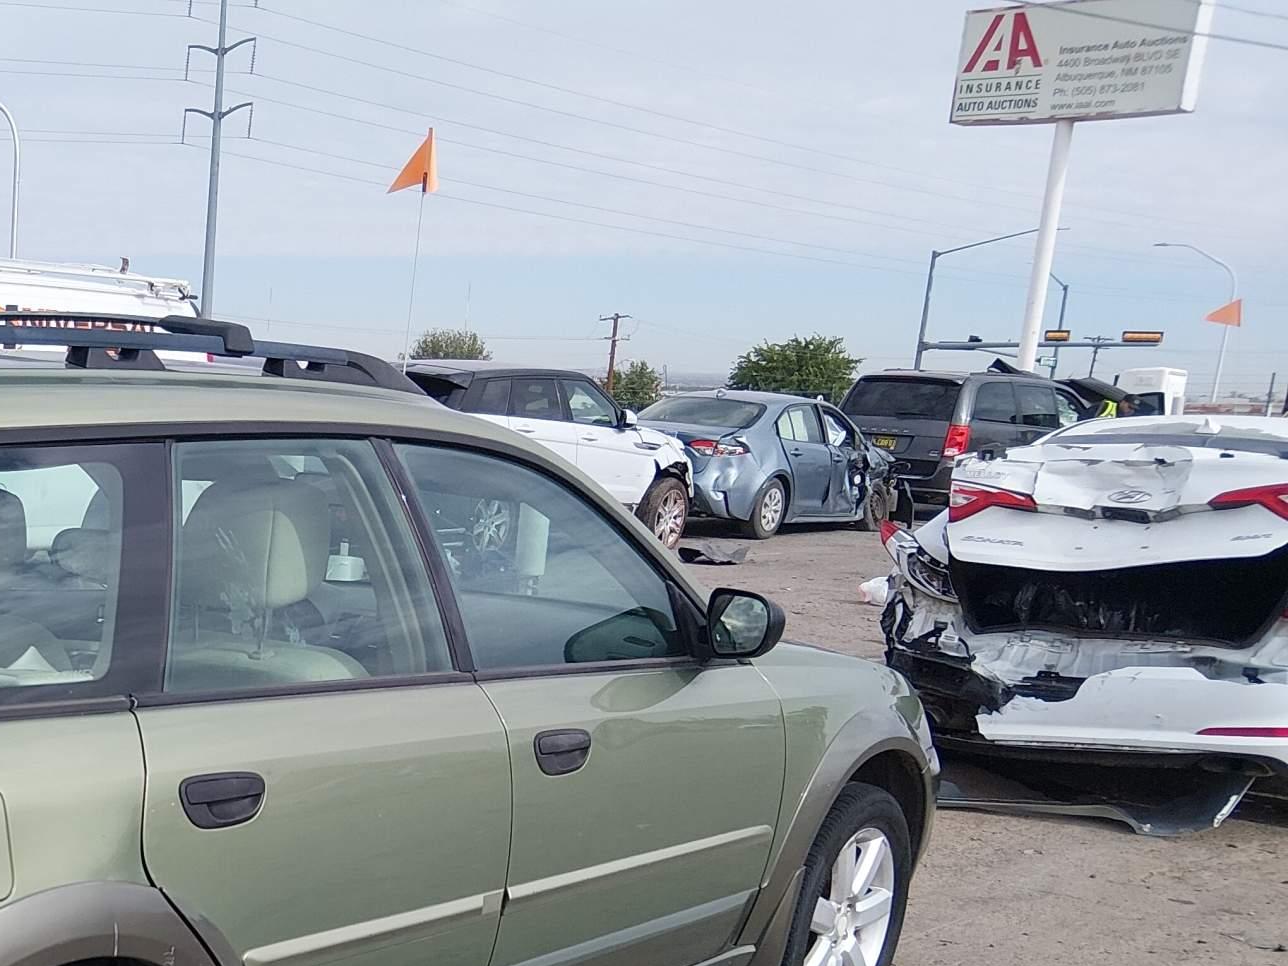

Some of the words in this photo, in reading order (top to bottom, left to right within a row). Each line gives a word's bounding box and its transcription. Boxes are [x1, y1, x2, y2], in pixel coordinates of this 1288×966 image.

[1059, 43, 1109, 55] Insurance
[1112, 40, 1137, 50] Auto
[1139, 36, 1188, 48] Auctions
[959, 79, 1041, 95] INSURANCE
[956, 100, 984, 113] AUTO
[986, 98, 1039, 111] AUCTIONS
